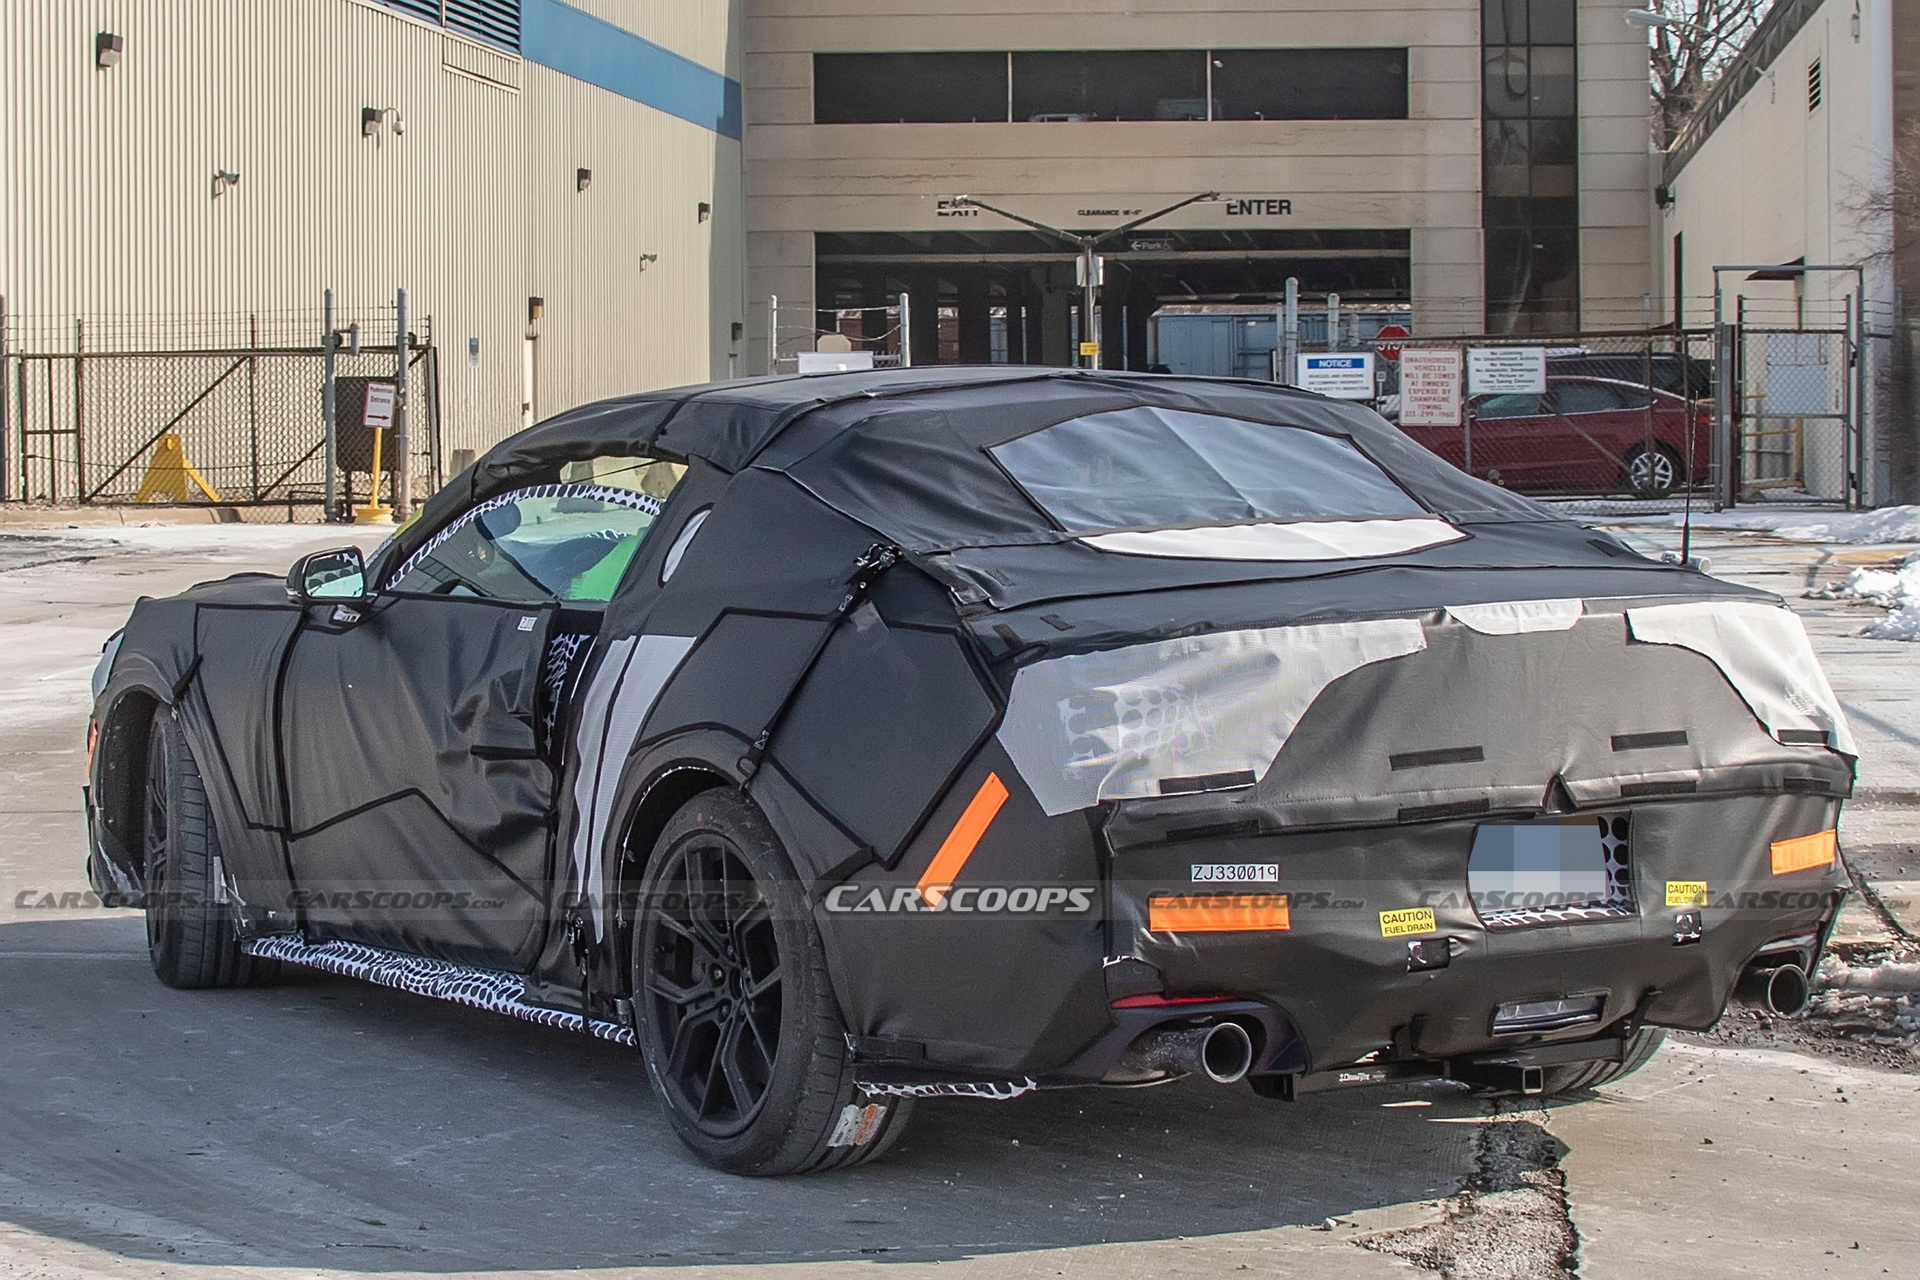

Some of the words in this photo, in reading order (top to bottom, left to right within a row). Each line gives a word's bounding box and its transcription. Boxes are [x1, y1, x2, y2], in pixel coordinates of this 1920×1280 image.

[1227, 200, 1291, 215] ENTER
[1318, 360, 1353, 368] NOTICE
[1193, 866, 1277, 880] ZJ330019
[1668, 884, 1705, 894] CAUTION
[1668, 896, 1684, 904] FUEL
[1382, 910, 1432, 924] CAUTION
[1385, 926, 1406, 934] FUEL
[1407, 923, 1433, 932] DRAIN
